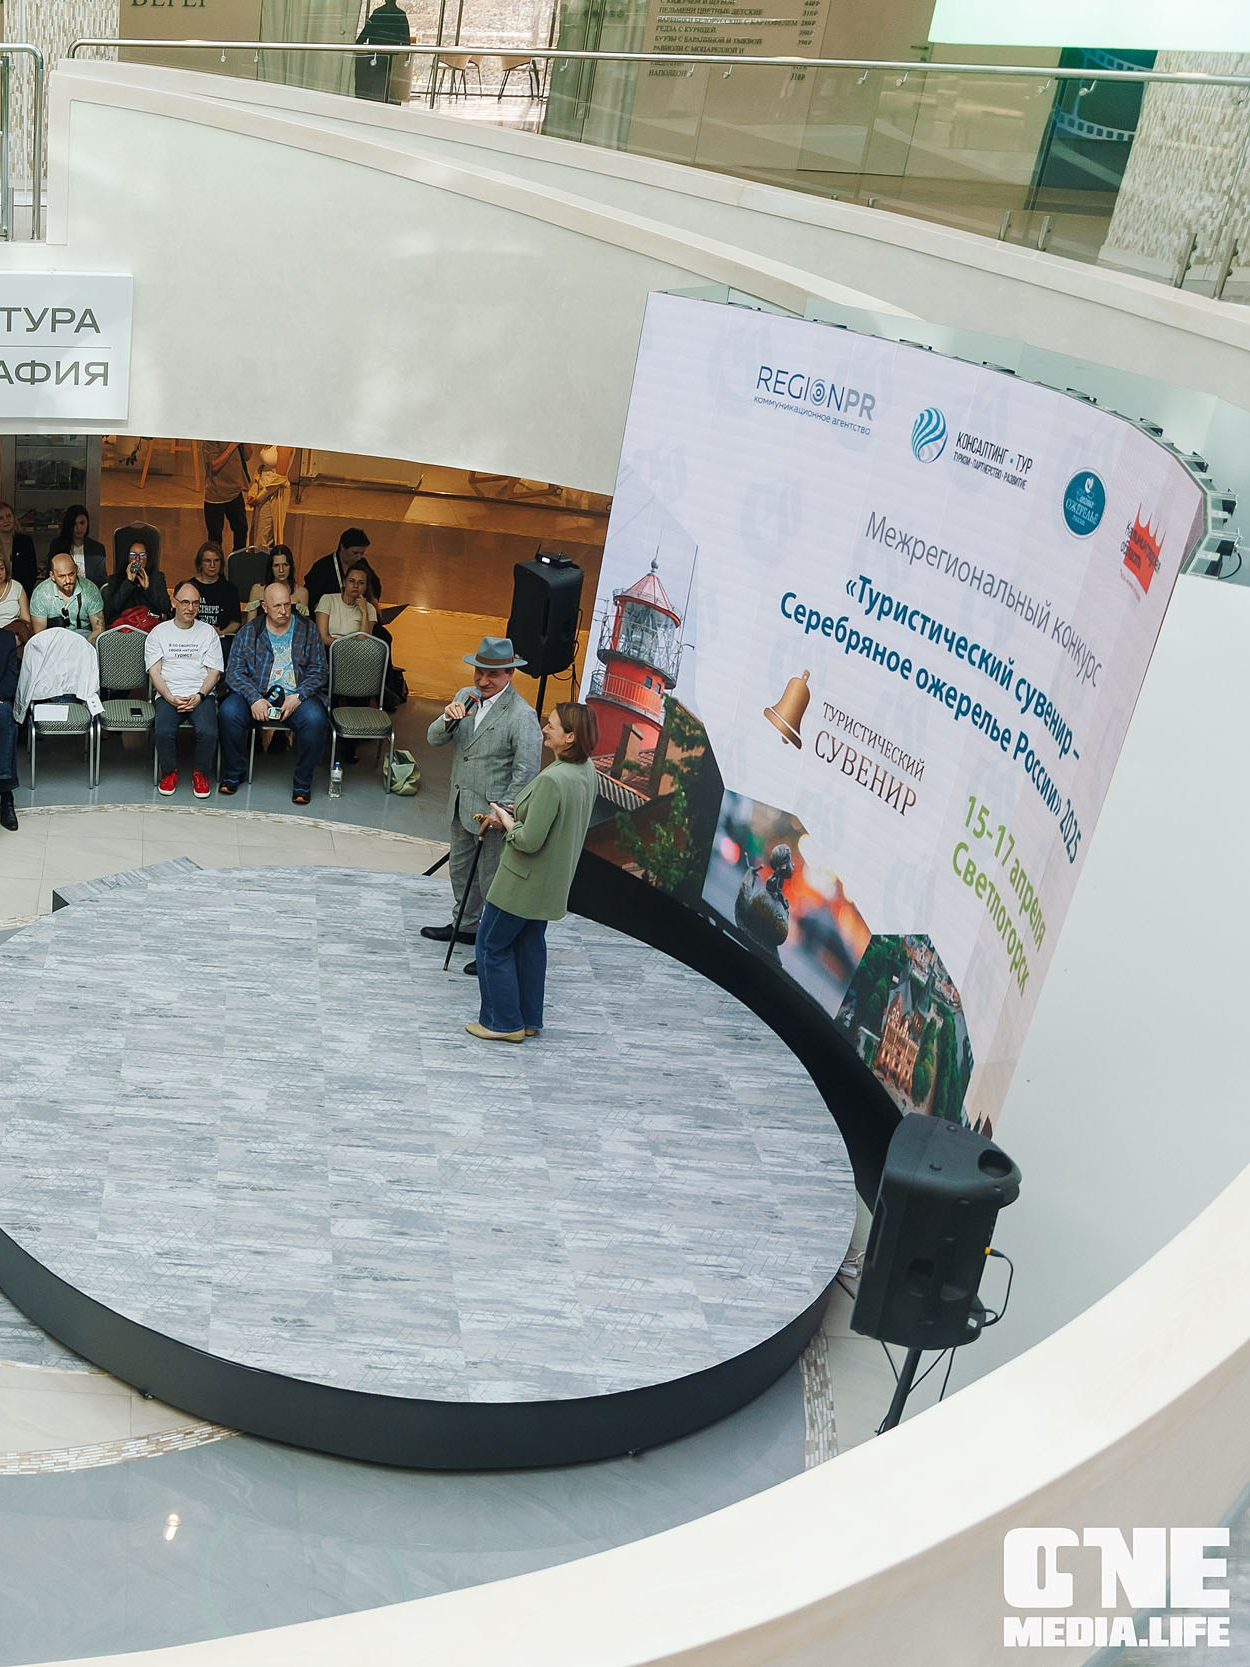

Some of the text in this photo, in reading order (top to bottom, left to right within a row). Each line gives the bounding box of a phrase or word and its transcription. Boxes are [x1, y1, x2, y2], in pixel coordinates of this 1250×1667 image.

[754, 396, 871, 436] коммуникационное агентство
[955, 431, 1033, 475] КОНСАЛТИНГ ТУР
[845, 574, 1014, 690] «Туристический
[1014, 677, 1073, 760] сувенир
[865, 511, 1102, 688] Межрегиональный конкурс
[780, 592, 1082, 865] Серебряное ожерелье России» 2025
[815, 730, 917, 816] СУВЕНИР
[823, 702, 925, 782] ТУРИСТИЧЕСКИЙ
[952, 842, 1030, 997] Светлогорск
[965, 795, 1046, 953] 15-17 апреля
